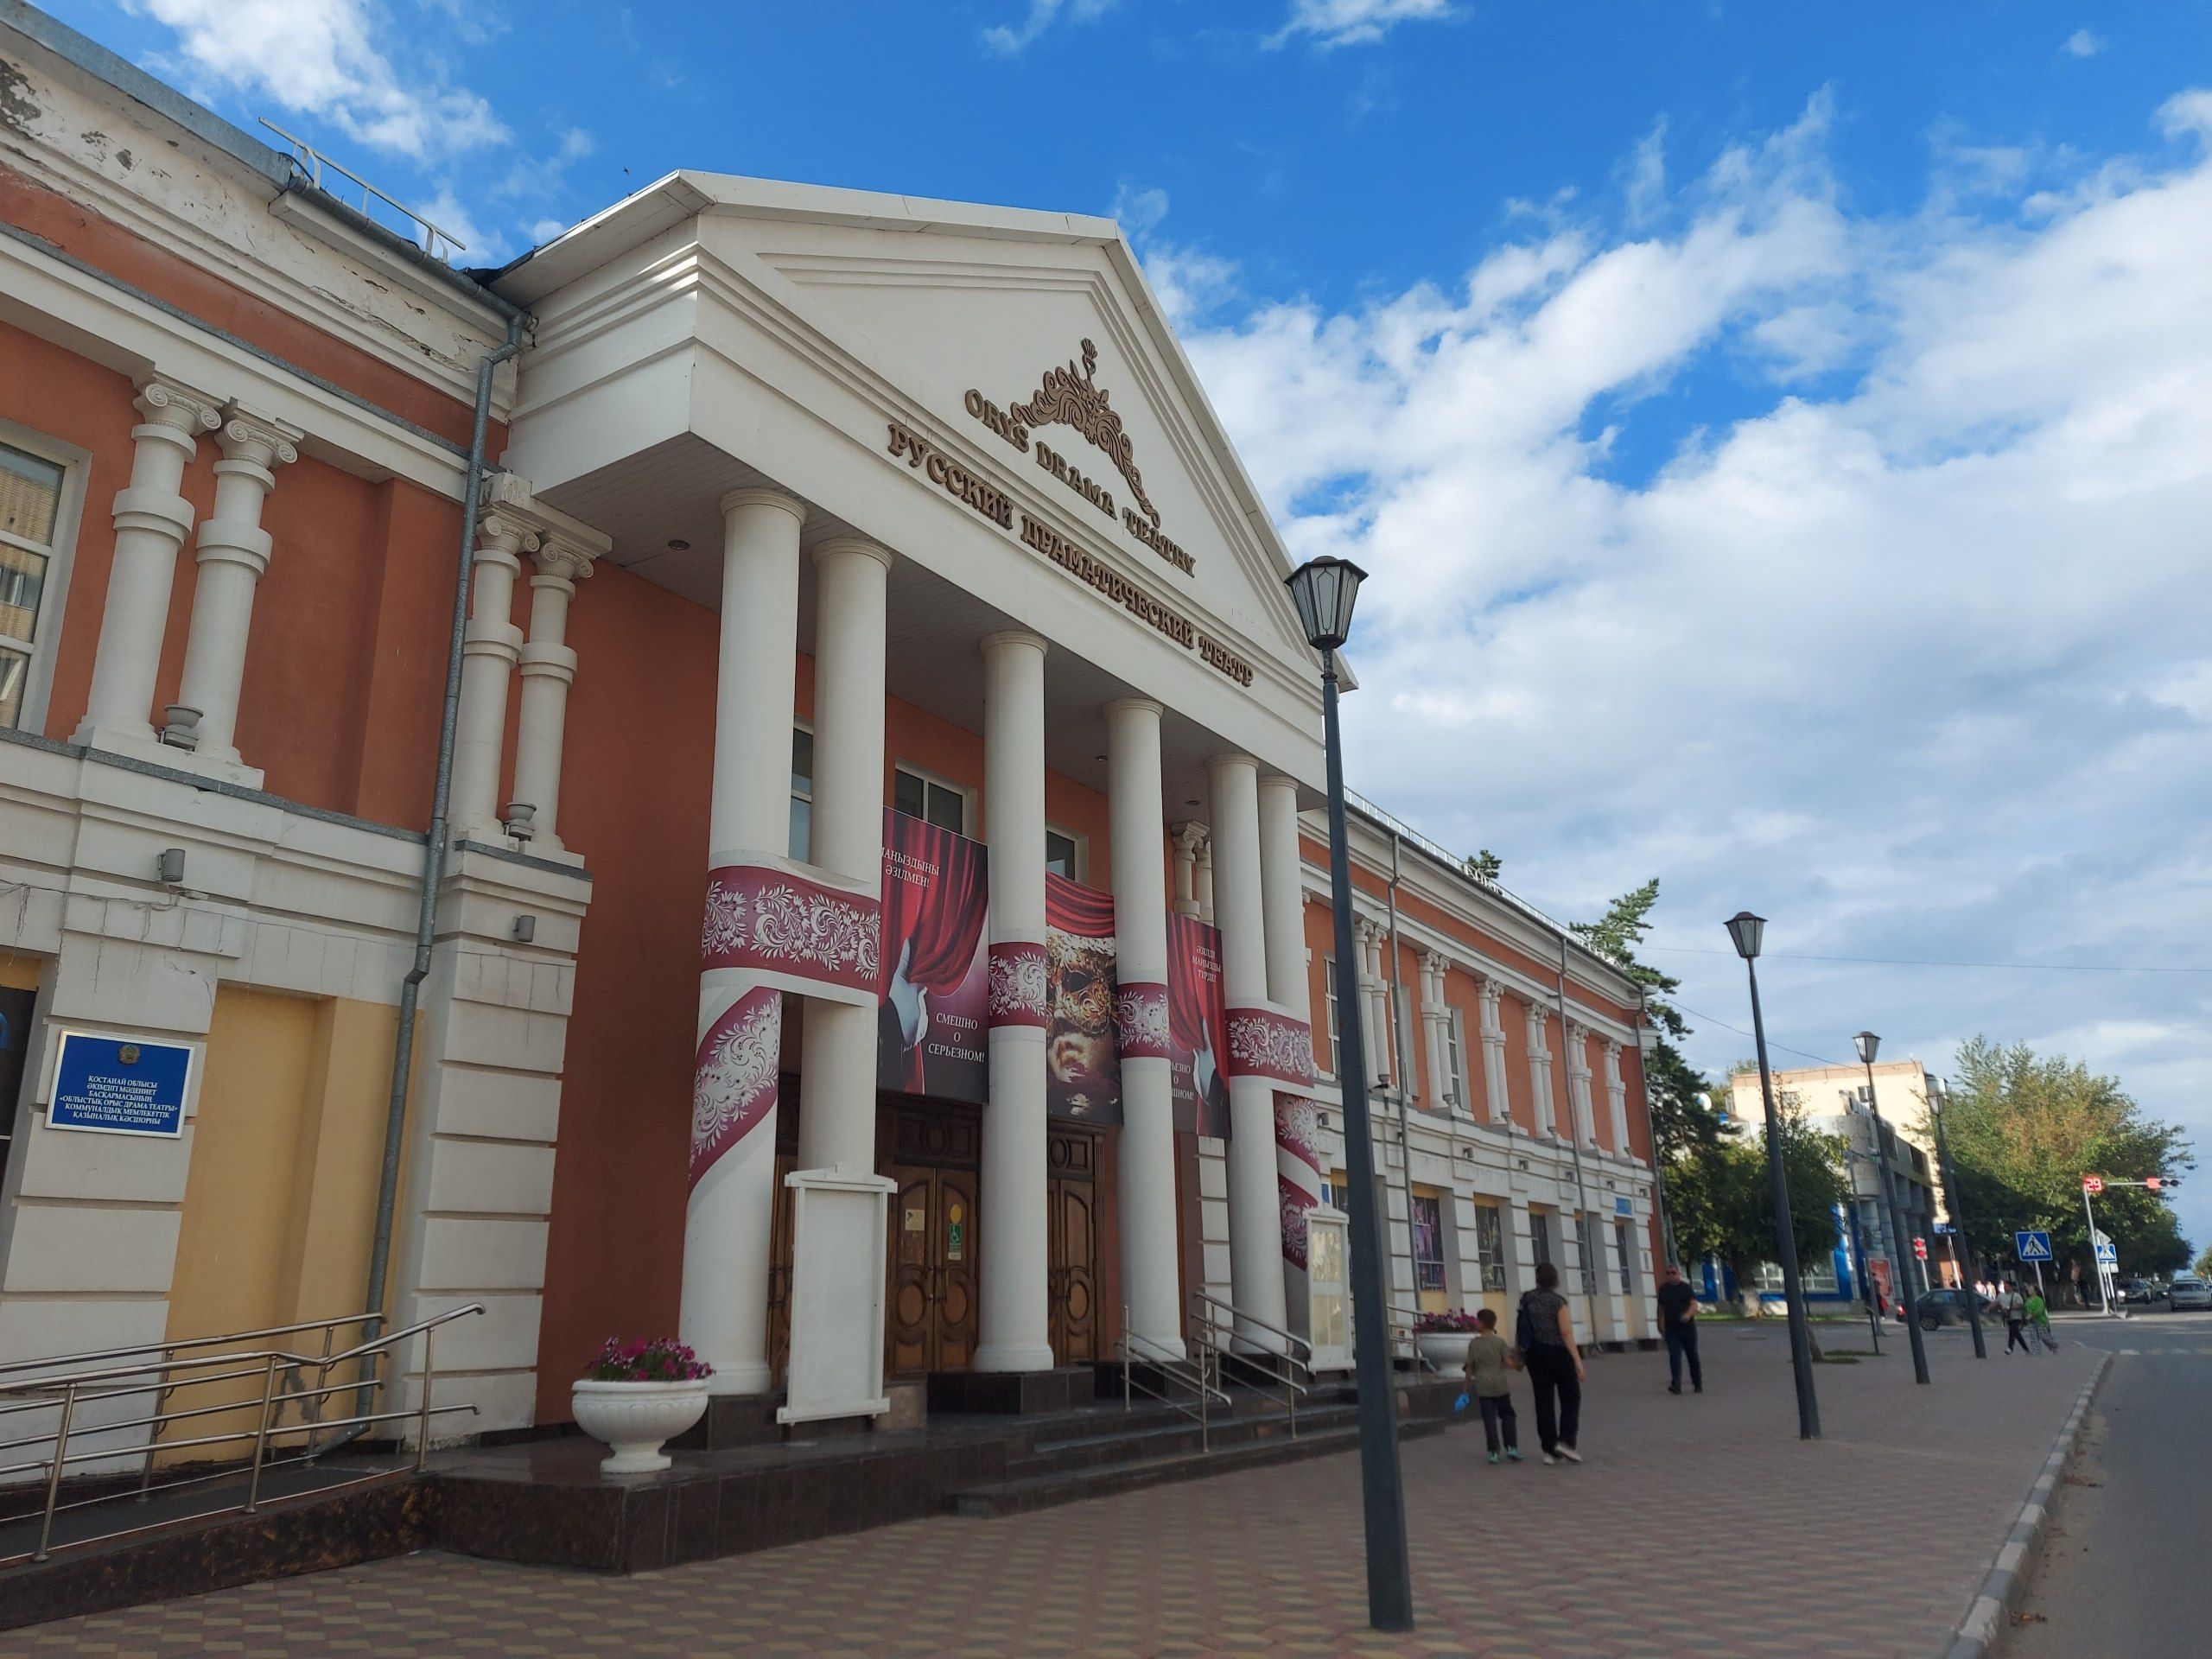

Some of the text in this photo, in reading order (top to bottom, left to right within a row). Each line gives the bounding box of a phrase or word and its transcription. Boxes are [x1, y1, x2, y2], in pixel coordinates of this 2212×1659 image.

[964, 389, 1196, 578] ORYS DRAMA TEATRY
[887, 423, 1254, 688] РУССКИЙ ДРАМАТИЧЕСКИЙ ТЕАТР
[886, 864, 930, 888] ӘЗІЛМЕН!
[936, 1013, 978, 1030] СМЕШНО
[953, 1032, 961, 1042] О
[928, 1043, 985, 1063] СЕРЬЕЗНОМ!
[127, 1080, 157, 1089] ОБЛЫСЫ
[1173, 1075, 1179, 1084] О
[119, 1086, 156, 1096] МӘДЕНИЕТ
[124, 1101, 148, 1109] ДРАМА
